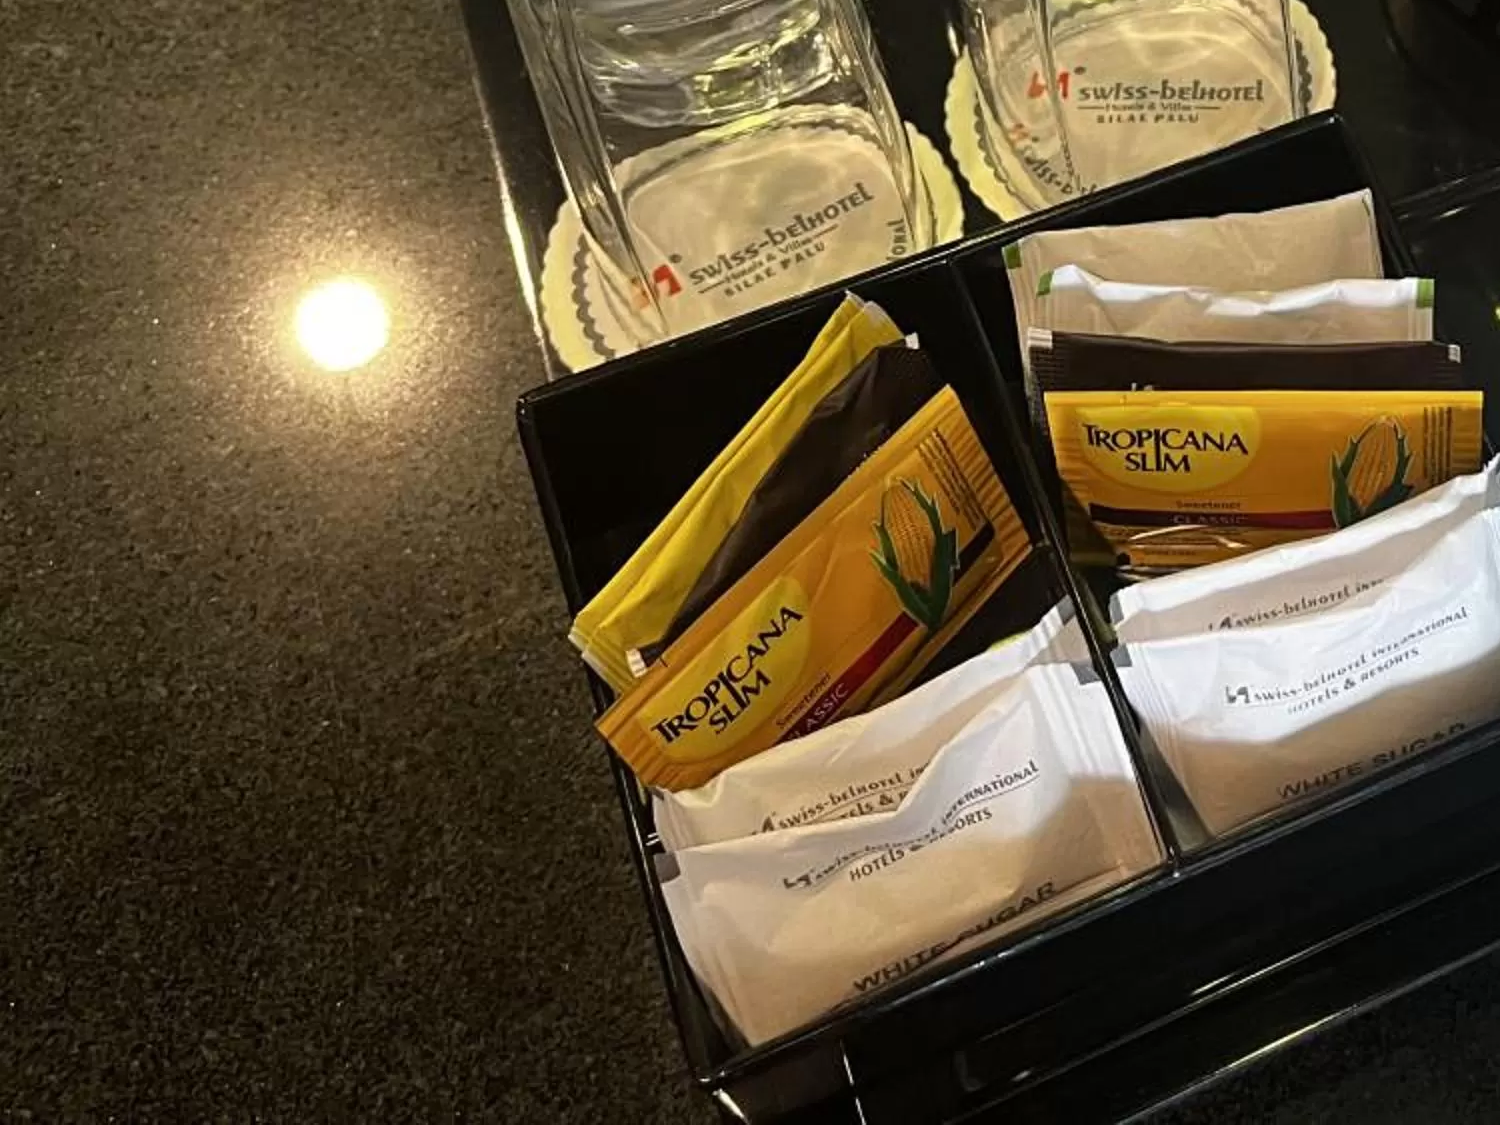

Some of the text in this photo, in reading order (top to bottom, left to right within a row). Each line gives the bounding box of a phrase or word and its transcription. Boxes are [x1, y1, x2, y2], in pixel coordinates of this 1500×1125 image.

[1082, 424, 1249, 457] TROPICANA
[1125, 447, 1191, 473] SLIM
[650, 606, 804, 743] TROPICANA
[709, 669, 771, 735] SLIM
[1276, 761, 1363, 798] WHITE
[853, 941, 948, 992] WHITE
